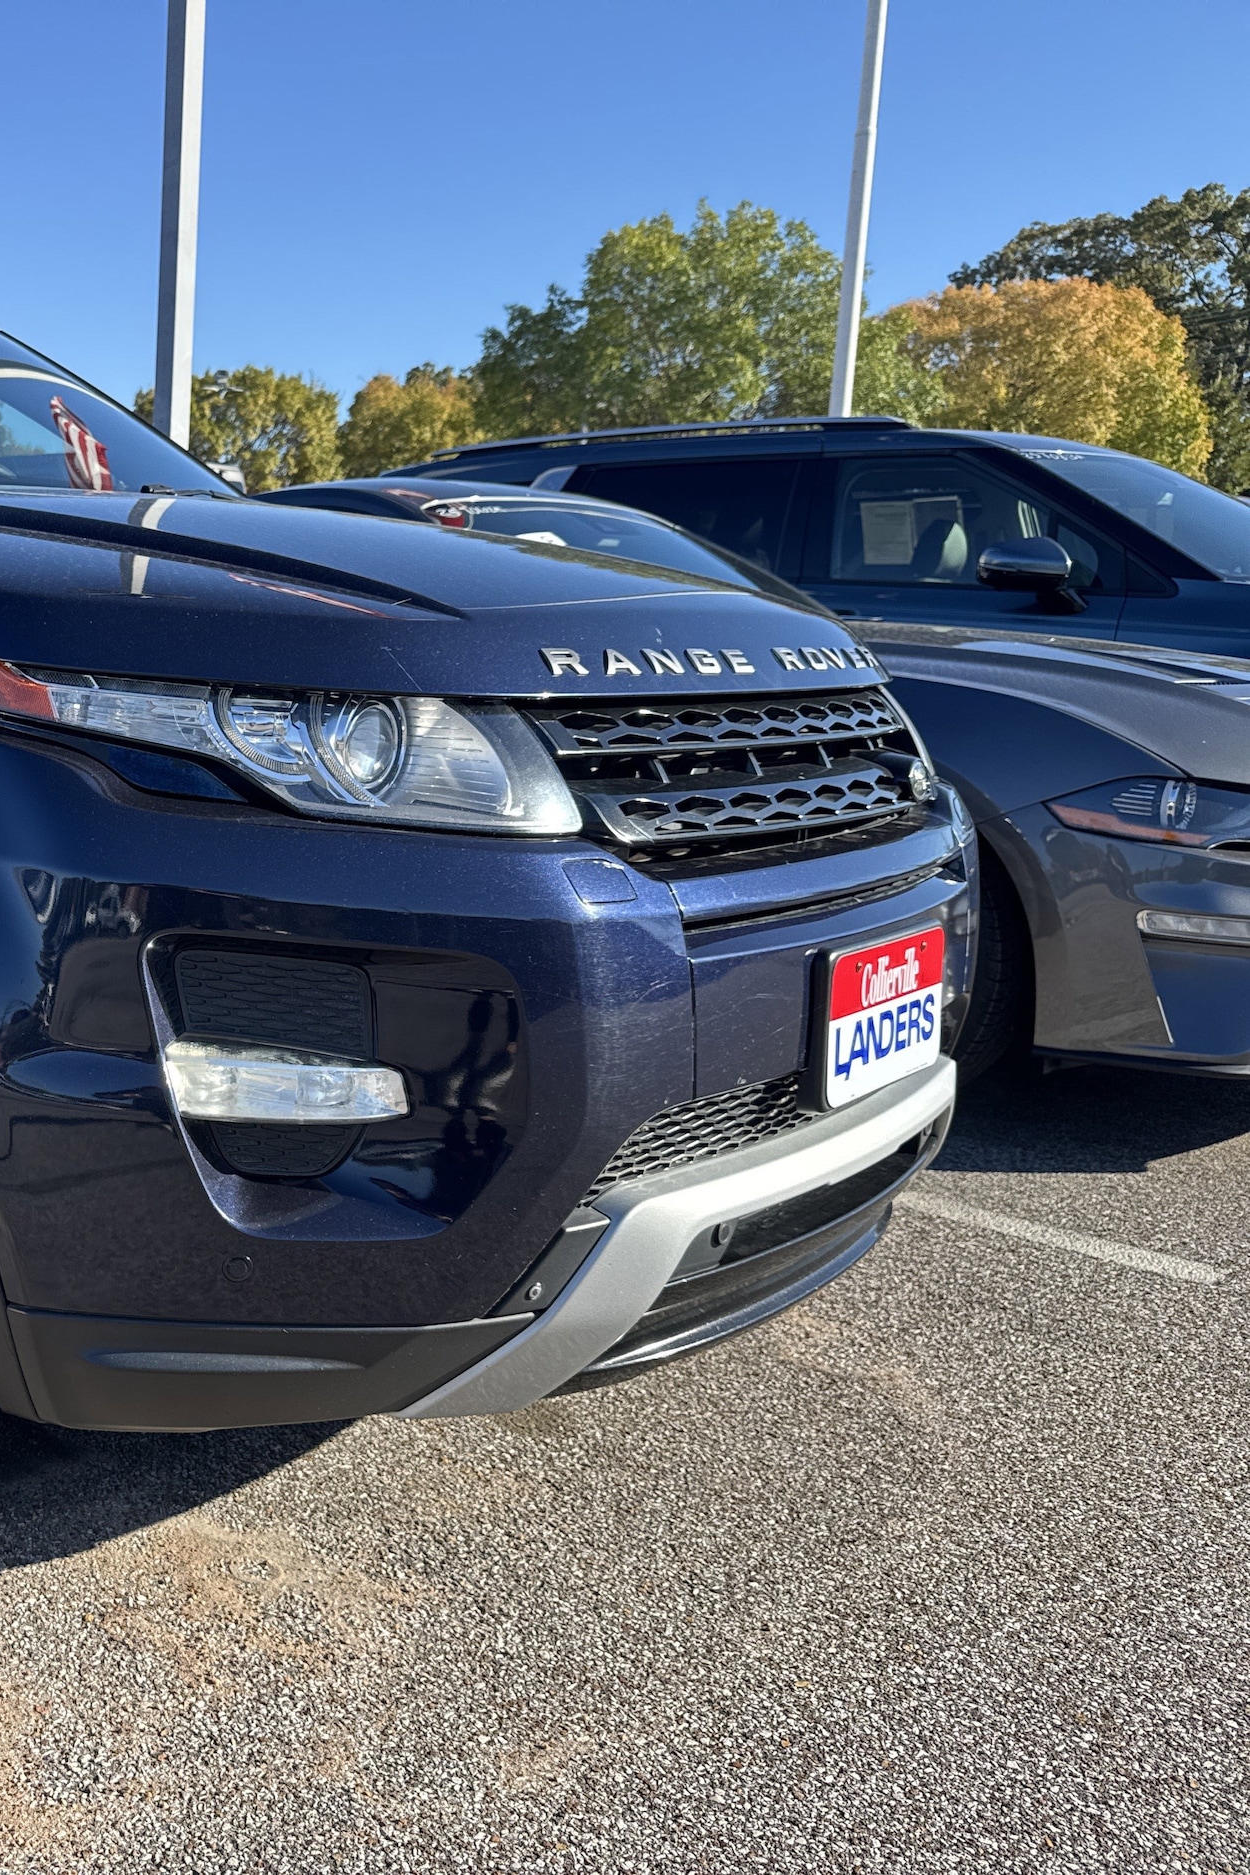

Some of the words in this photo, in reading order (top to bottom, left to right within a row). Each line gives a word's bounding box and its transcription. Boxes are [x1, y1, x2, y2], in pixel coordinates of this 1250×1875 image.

[538, 647, 756, 677] RANGE
[769, 645, 881, 672] ROVER
[861, 946, 920, 1009] Collierville
[834, 992, 936, 1082] LANDERS
